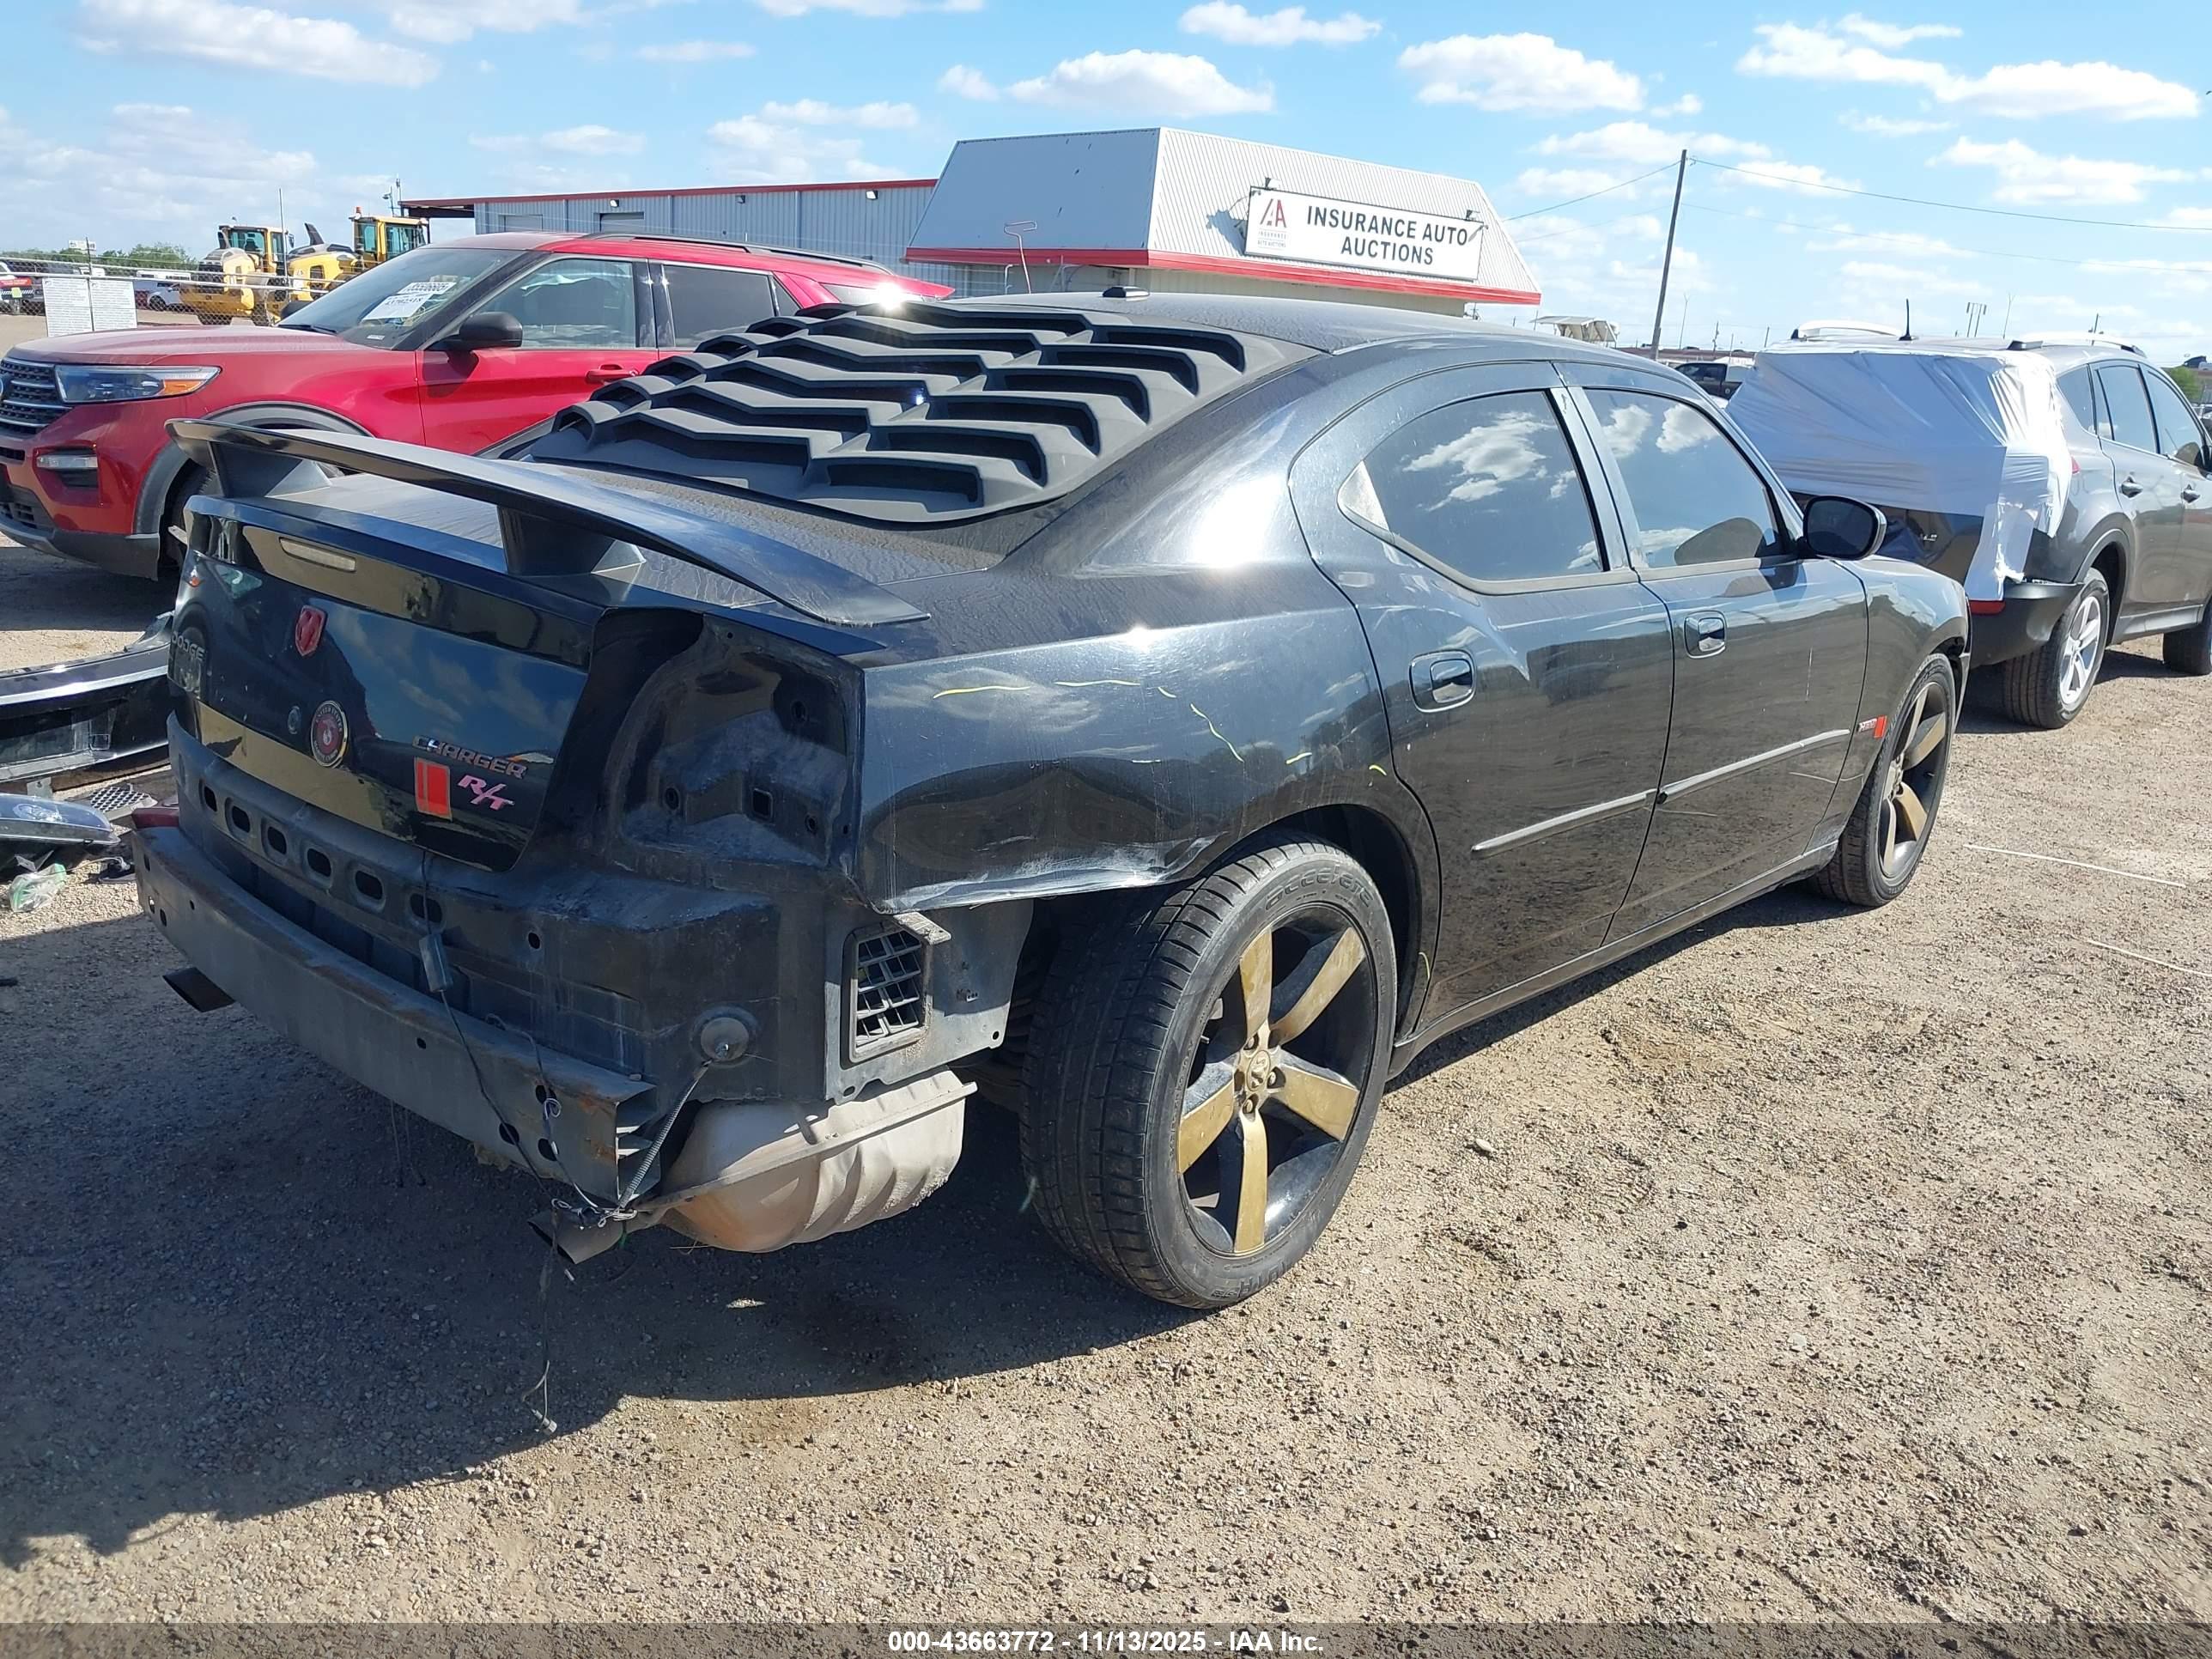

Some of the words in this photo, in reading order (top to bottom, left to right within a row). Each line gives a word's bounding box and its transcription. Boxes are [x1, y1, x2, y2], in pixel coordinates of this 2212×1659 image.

[1307, 205, 1417, 239] INSURANCE
[1422, 222, 1468, 246] AUTO
[1340, 236, 1434, 265] AUCTIONS
[171, 630, 205, 661] DODGE
[412, 735, 528, 779] CHARGER
[458, 775, 515, 811] R/T
